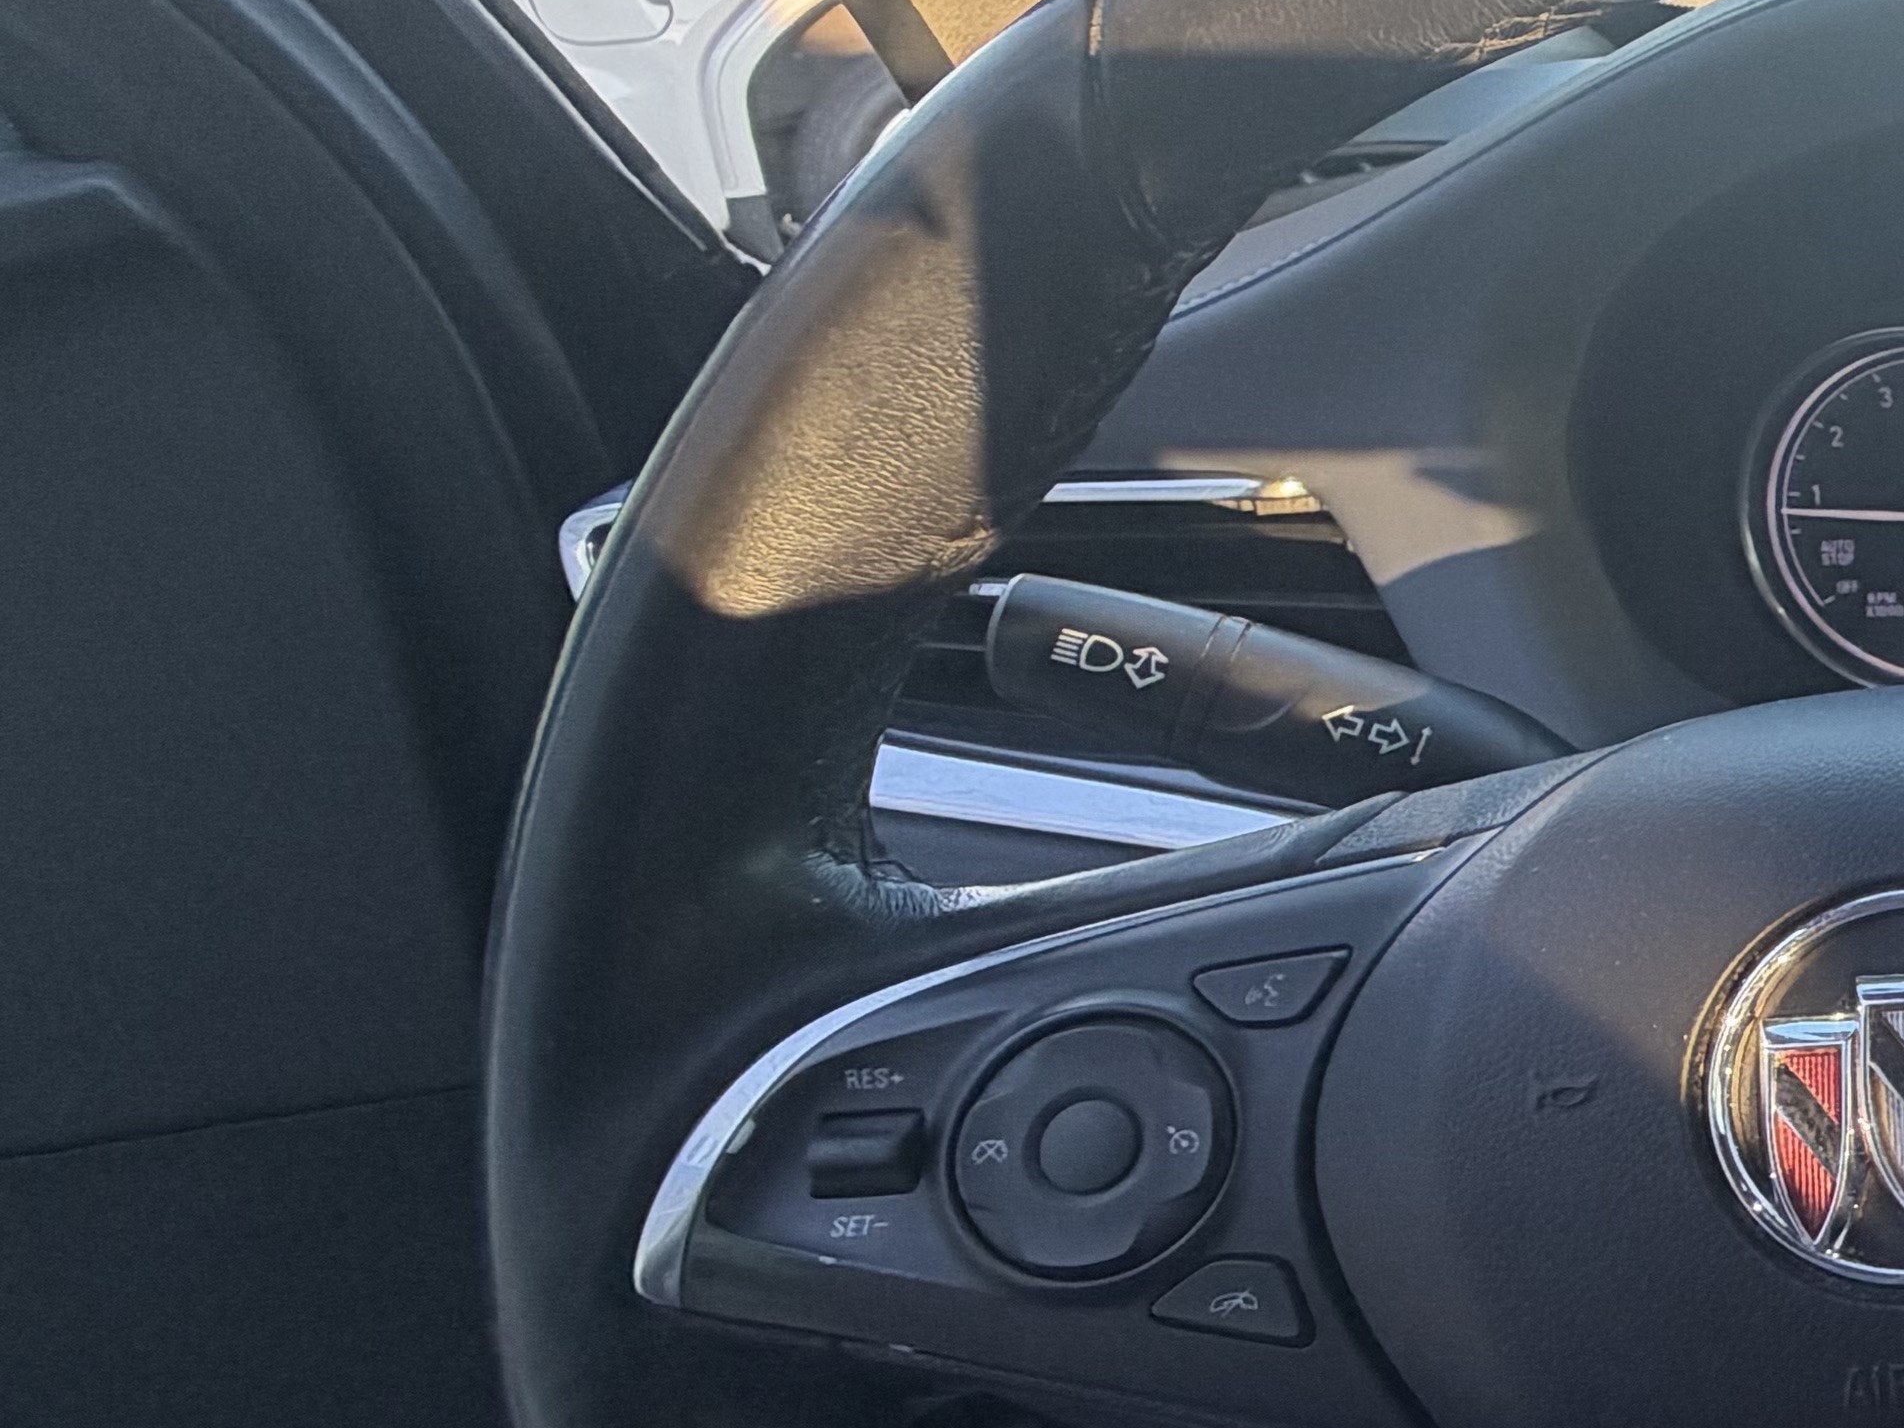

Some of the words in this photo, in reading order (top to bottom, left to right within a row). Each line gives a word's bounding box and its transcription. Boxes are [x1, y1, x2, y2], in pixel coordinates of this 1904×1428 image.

[1879, 386, 1893, 408] 3
[1829, 425, 1844, 448] 2
[1811, 484, 1821, 504] 1
[844, 1069, 904, 1090] RES+
